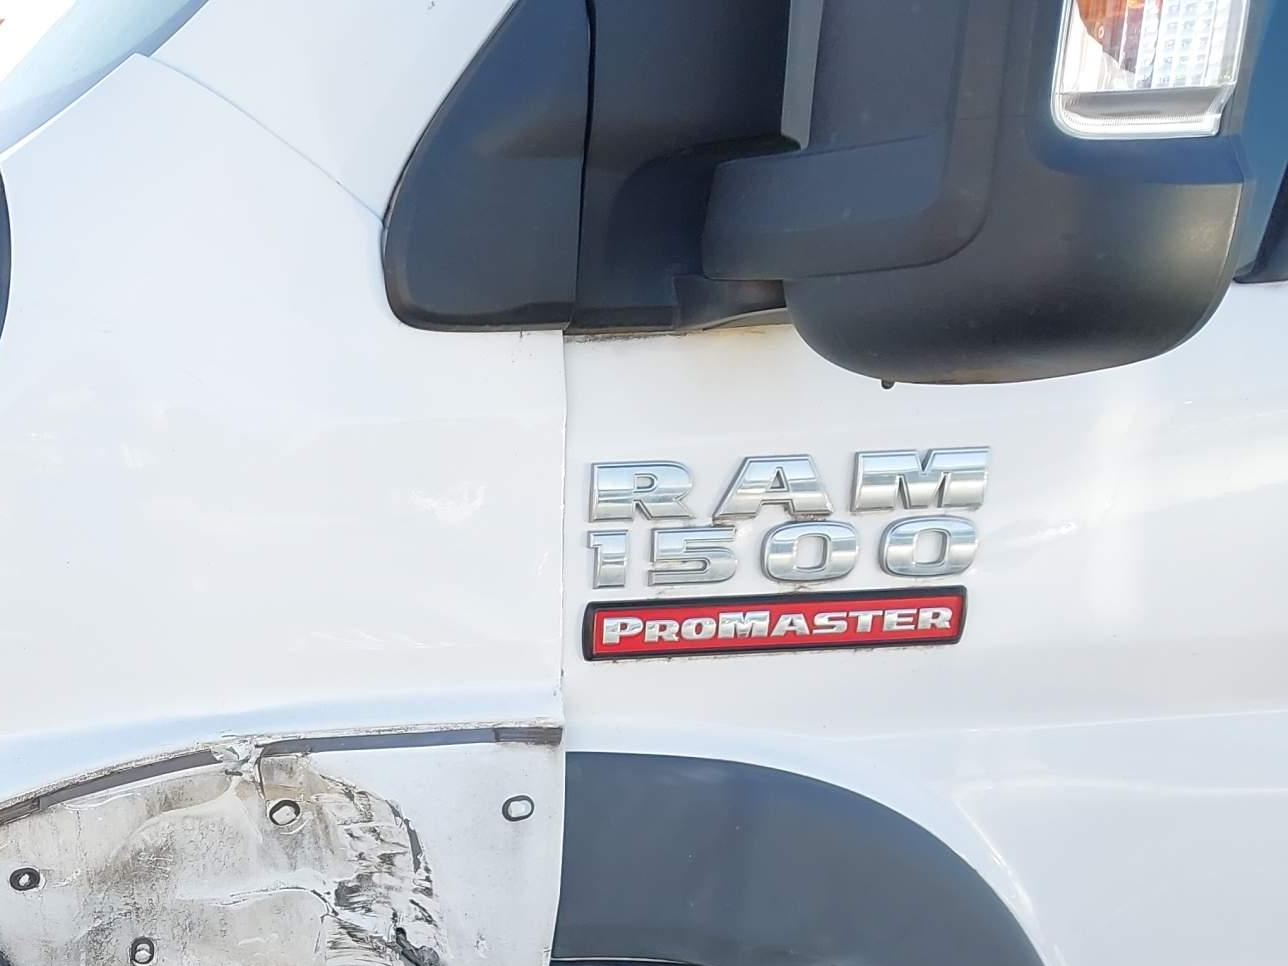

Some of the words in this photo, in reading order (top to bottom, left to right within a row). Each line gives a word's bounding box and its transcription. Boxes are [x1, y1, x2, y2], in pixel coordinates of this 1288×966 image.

[588, 446, 991, 523] RAM
[587, 515, 979, 589] 1500
[601, 606, 954, 645] PROMASTER
